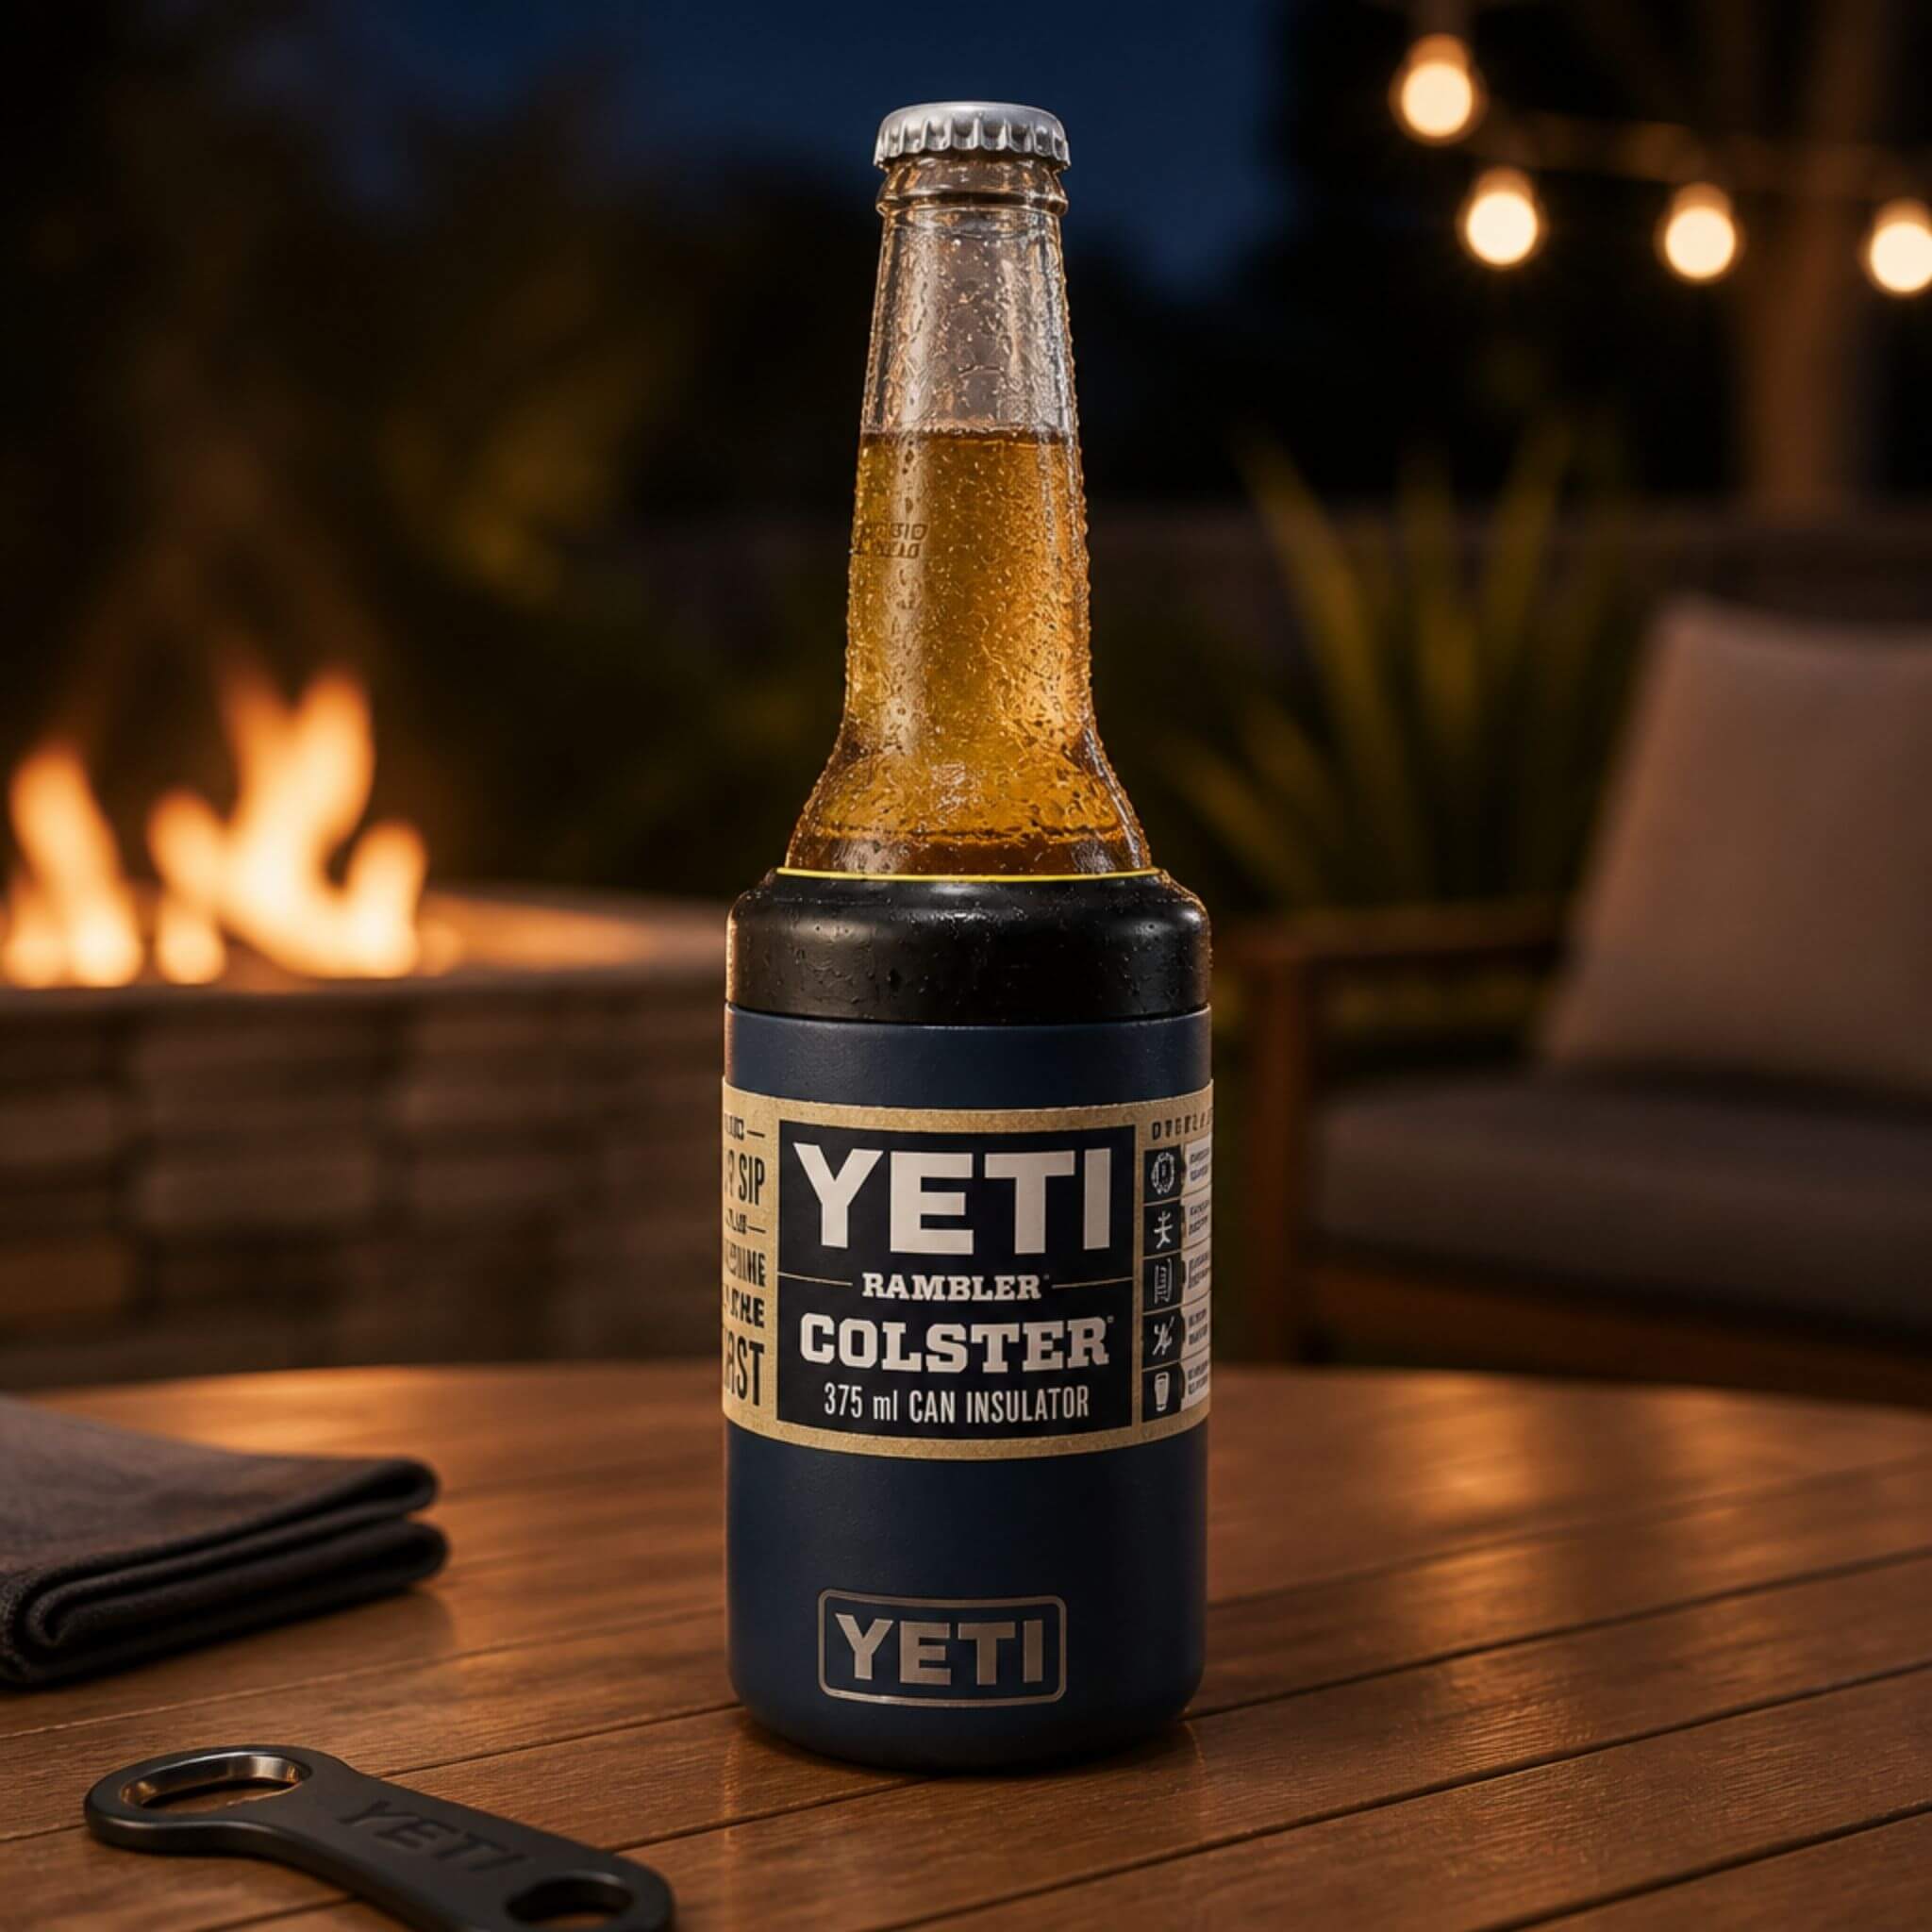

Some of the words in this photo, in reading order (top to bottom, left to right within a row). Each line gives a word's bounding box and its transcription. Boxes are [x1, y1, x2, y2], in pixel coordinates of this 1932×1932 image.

[739, 1152, 766, 1206] SIP
[793, 1142, 1111, 1256] YETI
[861, 1273, 1041, 1301] RAMBLER
[800, 1312, 1110, 1373] COLSTER
[824, 1382, 863, 1418] 375
[873, 1390, 898, 1422] ml
[908, 1390, 956, 1424] CAN
[966, 1385, 1090, 1424] INSULATOR
[835, 1612, 1043, 1686] YETI
[336, 1799, 526, 1873] YETI
